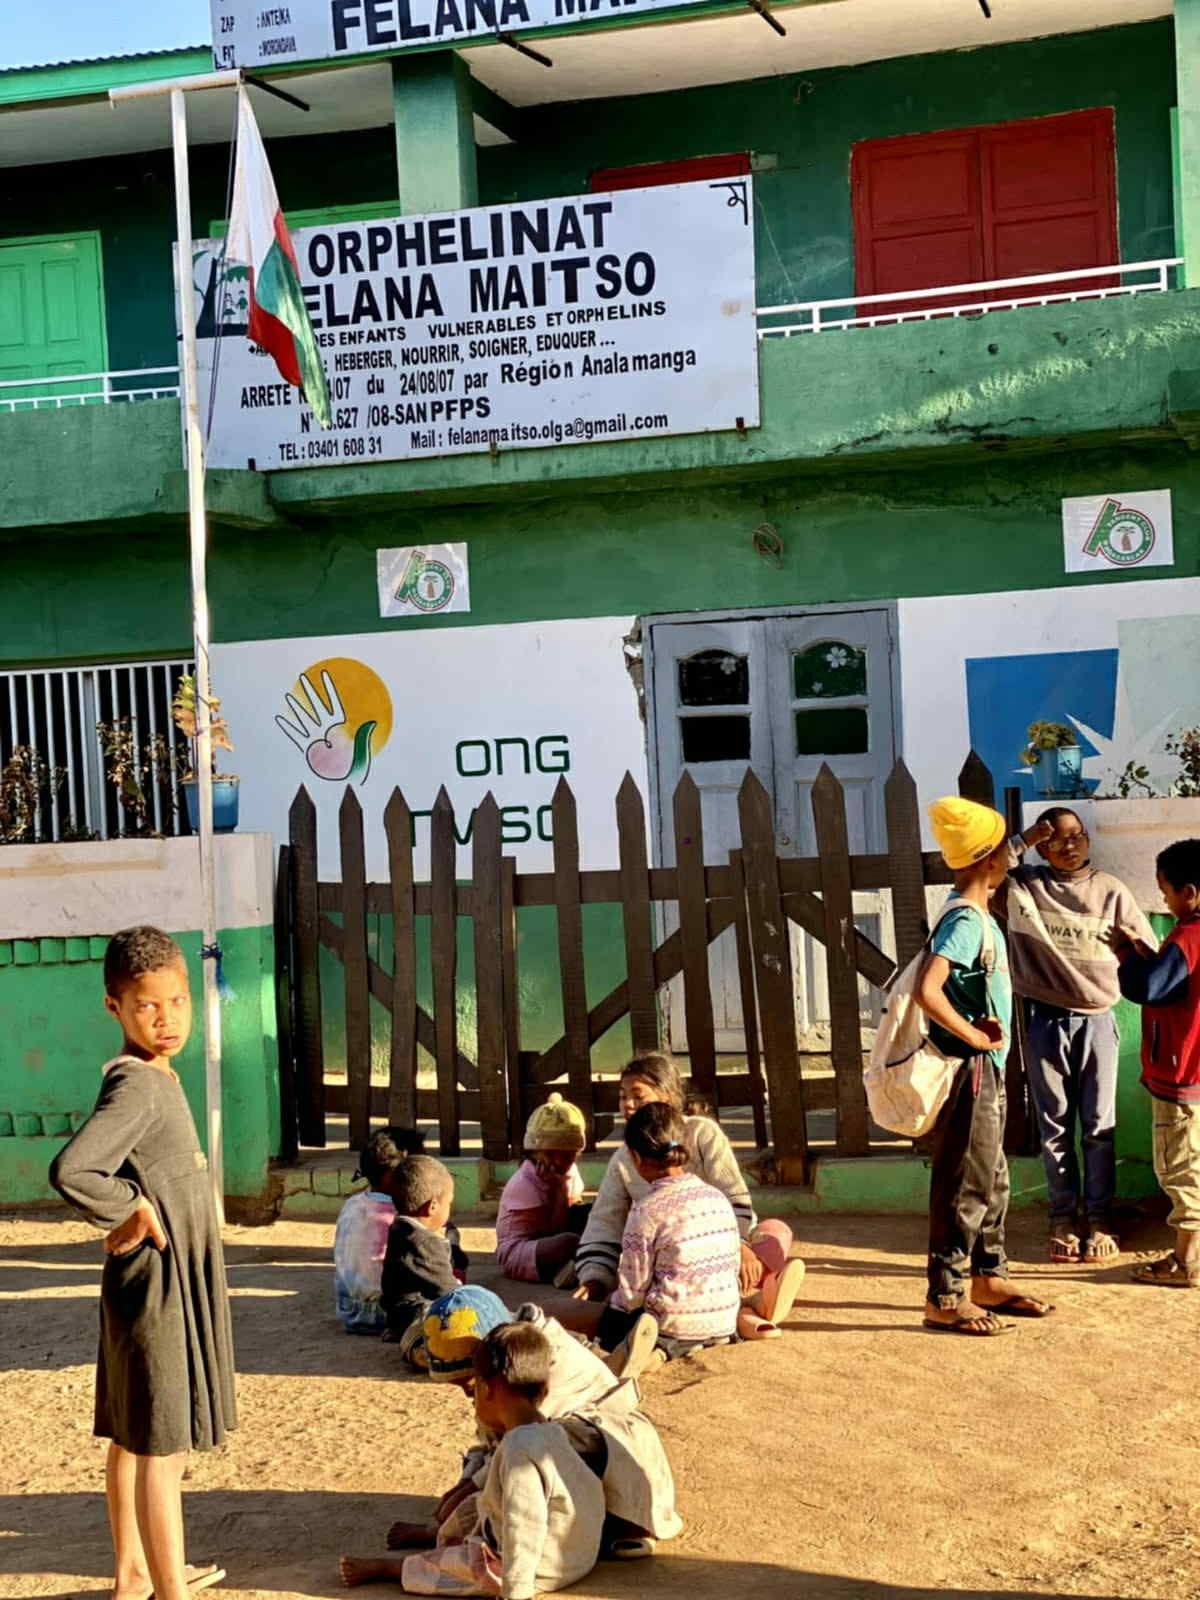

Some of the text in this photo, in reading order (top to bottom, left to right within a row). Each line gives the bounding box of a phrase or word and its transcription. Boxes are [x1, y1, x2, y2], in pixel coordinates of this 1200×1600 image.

[308, 201, 612, 277] ORPHELINAT
[302, 251, 656, 329] ELANA MAITSO
[340, 326, 406, 345] ENFANTS
[428, 315, 536, 338] VULNERABLES
[546, 312, 563, 327] ET
[567, 301, 666, 325] ORPHELINS
[335, 351, 397, 372] HEBERGER,
[402, 344, 465, 365] NOURRIR,
[469, 337, 533, 359] SOIGNER,
[241, 384, 291, 409] ARRETE
[367, 374, 385, 395] du
[399, 369, 455, 396] 24/08/07
[464, 371, 489, 394] par
[500, 360, 573, 386] Région
[368, 436, 383, 454] 31
